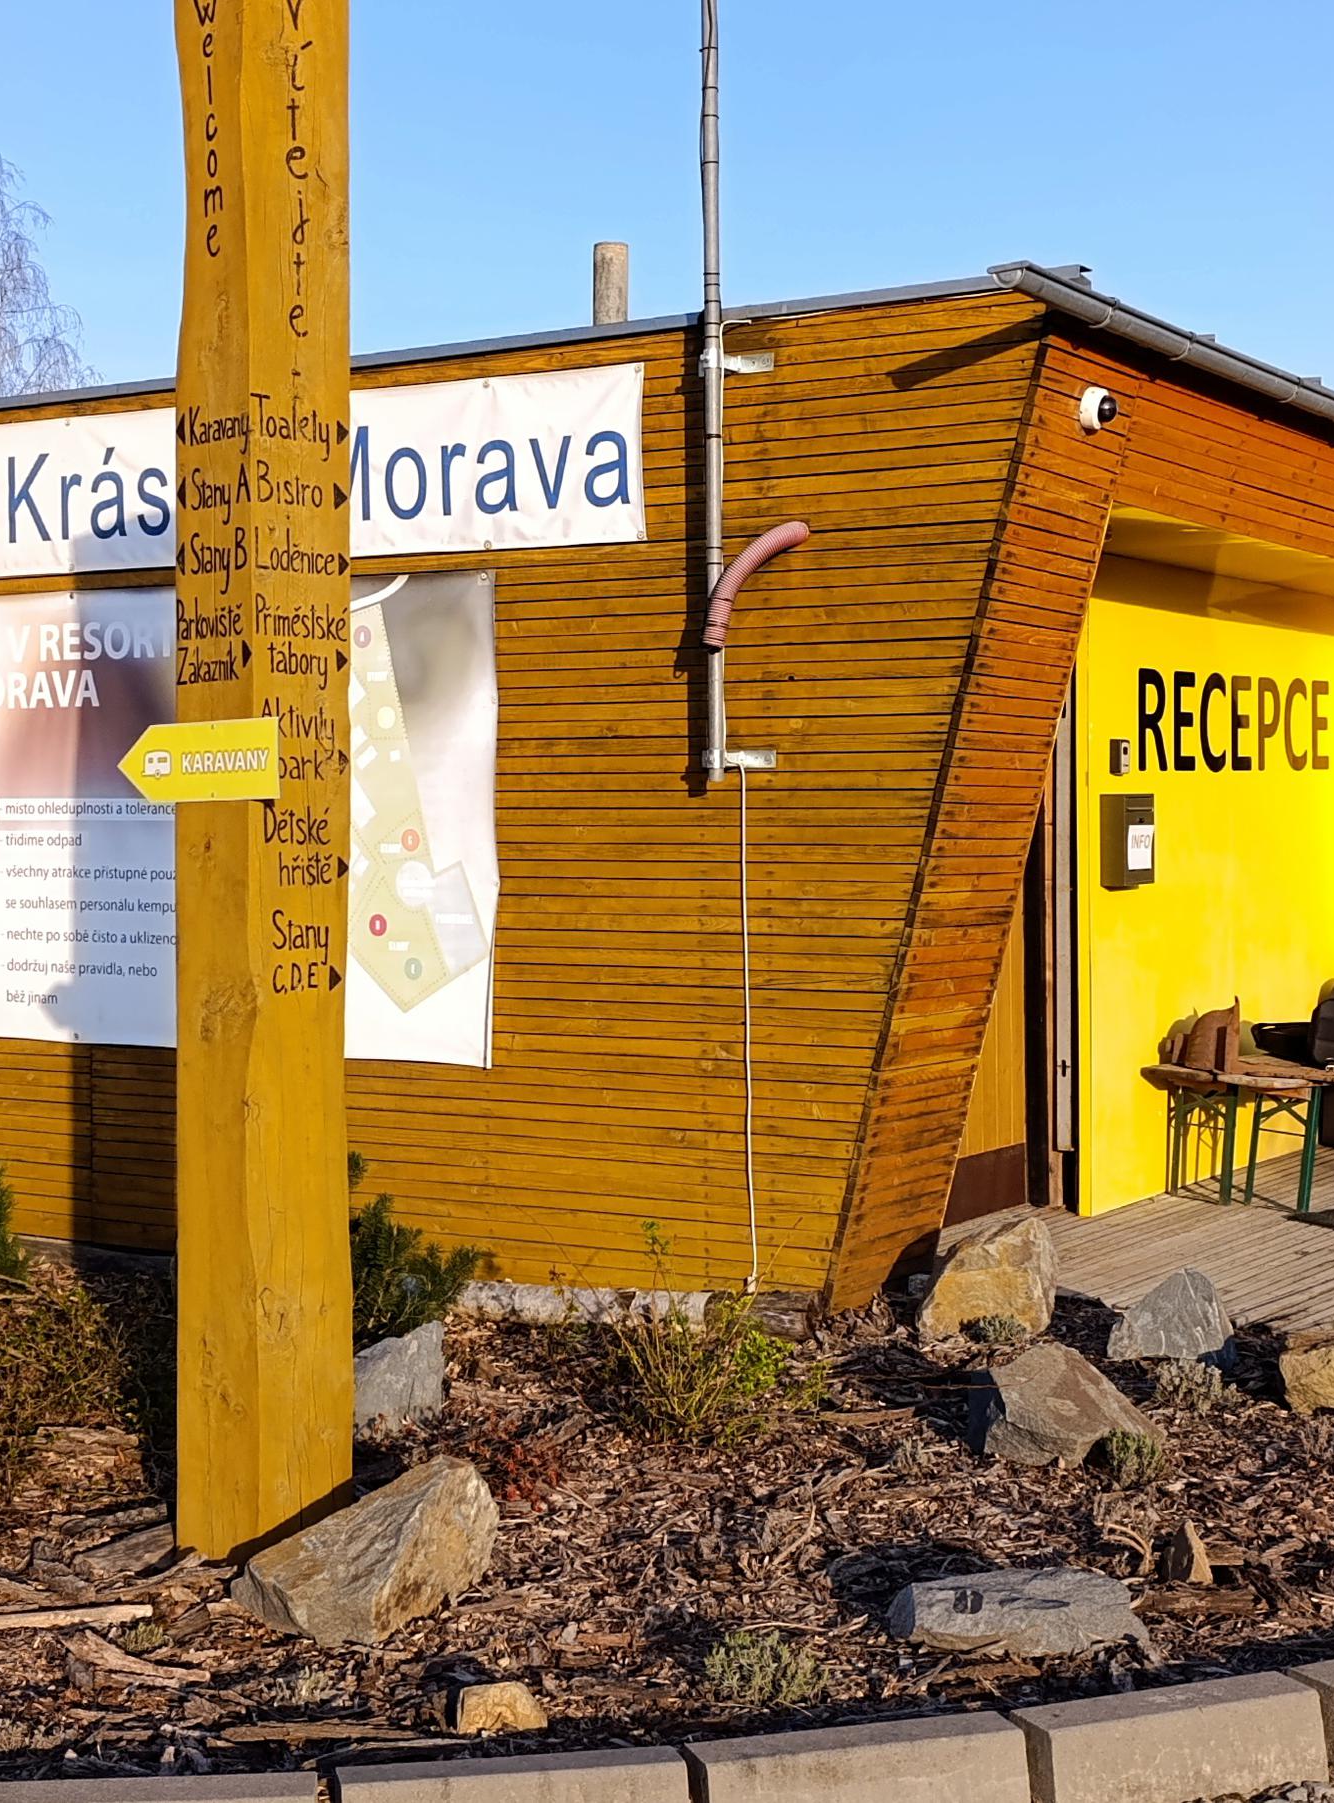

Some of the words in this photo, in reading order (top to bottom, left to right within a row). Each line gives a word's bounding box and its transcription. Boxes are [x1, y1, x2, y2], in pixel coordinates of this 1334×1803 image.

[188, 406, 253, 454] Karavany
[250, 393, 330, 462] Toalety
[191, 467, 231, 525] Stany
[235, 463, 251, 504] A
[257, 459, 323, 508] Bistro
[190, 532, 231, 595] Stany
[235, 526, 247, 571] B
[255, 526, 335, 576] Loděnice
[177, 597, 244, 641] Parkoviště
[255, 593, 348, 642] Příměstské
[8, 624, 31, 664] V
[177, 640, 240, 686] Zákazník
[268, 641, 328, 690] tábory
[1138, 667, 1329, 773] RECEPCE
[181, 749, 269, 774] KARAVANY
[5, 802, 35, 815] místo
[37, 801, 113, 818] ohleduplnosti
[116, 804, 122, 815] a
[125, 802, 176, 815] tolerance
[264, 803, 331, 845] Dětské
[46, 833, 82, 849] odpad
[1131, 834, 1151, 850] INFO
[6, 865, 49, 880] všechny
[51, 866, 91, 879] atrakce
[93, 867, 147, 882] přístupné
[280, 852, 333, 886] hřiště
[5, 899, 16, 909] se
[19, 896, 77, 910] souhlasem
[79, 898, 135, 913] personálu
[137, 899, 177, 915] kempu
[7, 928, 43, 942] nechte
[46, 932, 61, 945] po
[63, 929, 89, 943] sobě
[91, 930, 117, 943] čisto
[120, 934, 126, 943] a
[272, 909, 329, 965] Stany
[7, 959, 48, 975] dodržuj
[51, 961, 76, 974] naše
[78, 962, 126, 977] pravidla,
[128, 963, 157, 977] nebo
[6, 990, 25, 1003] běž
[27, 990, 58, 1005] jinam
